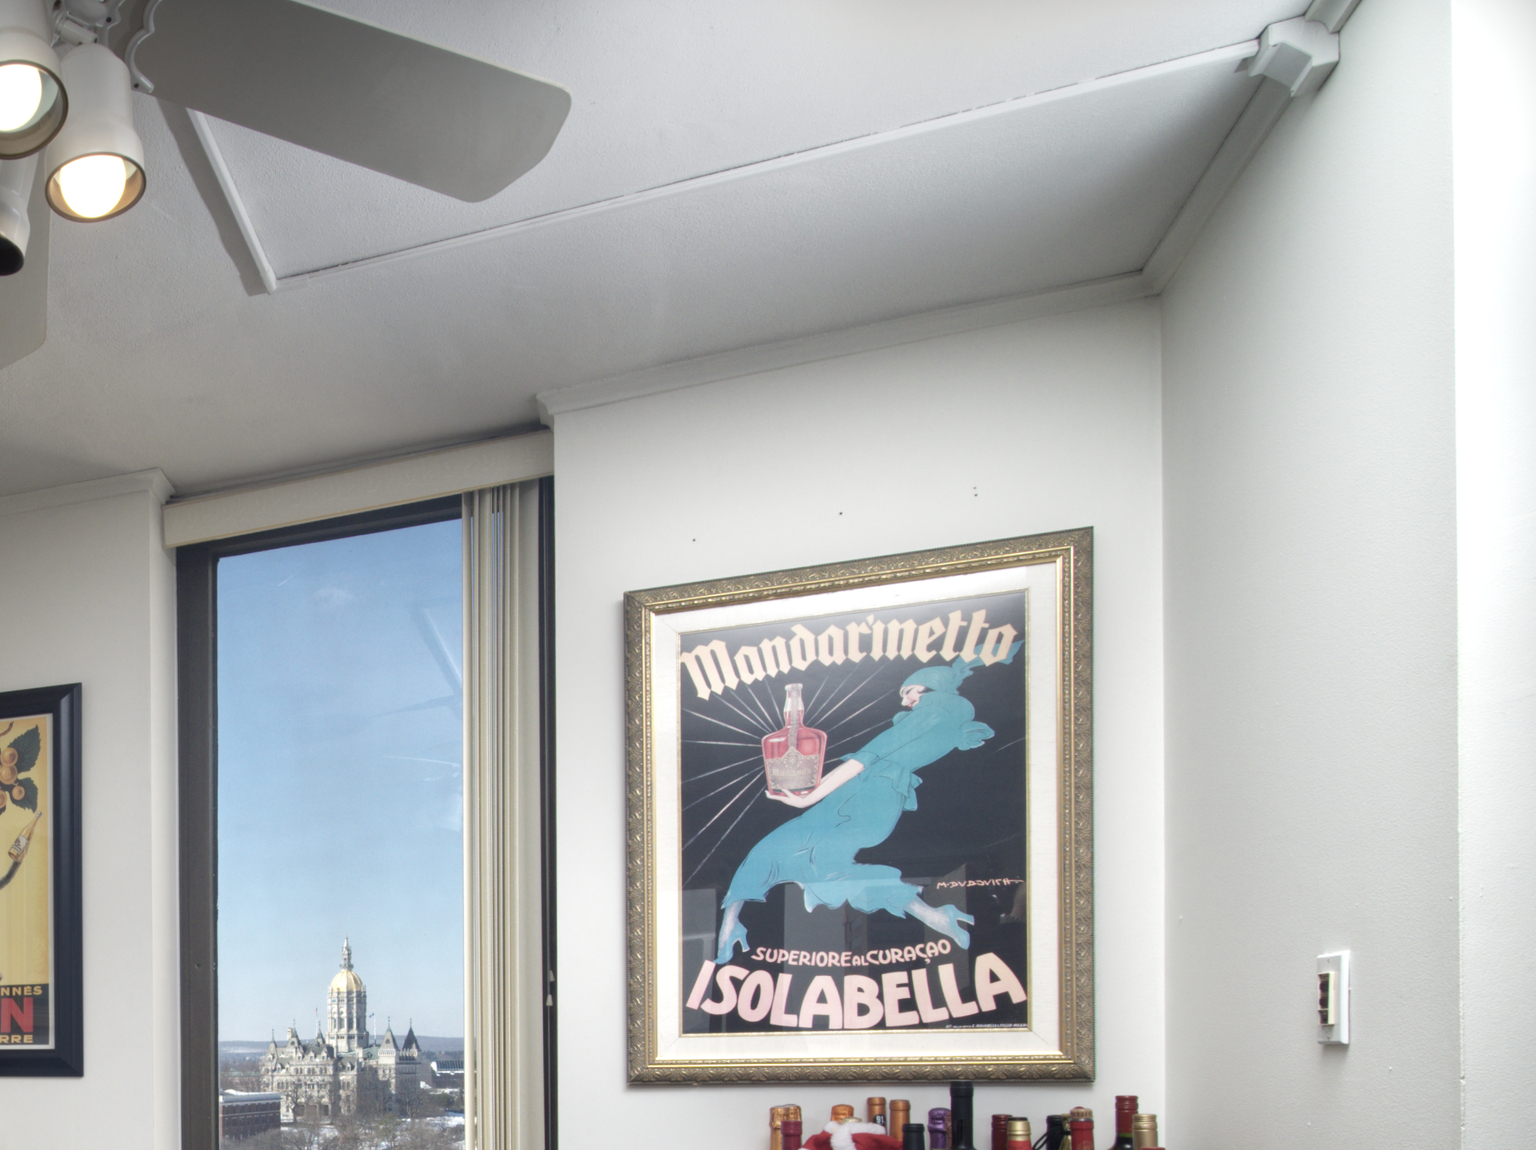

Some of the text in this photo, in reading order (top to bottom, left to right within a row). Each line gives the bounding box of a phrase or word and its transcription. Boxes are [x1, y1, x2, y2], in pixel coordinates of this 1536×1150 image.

[680, 609, 1018, 700] Mandarinetto
[686, 952, 1028, 1029] ISOLABELLA
[751, 947, 851, 967] SUPERIORE
[867, 938, 952, 964] CURAÇAO
